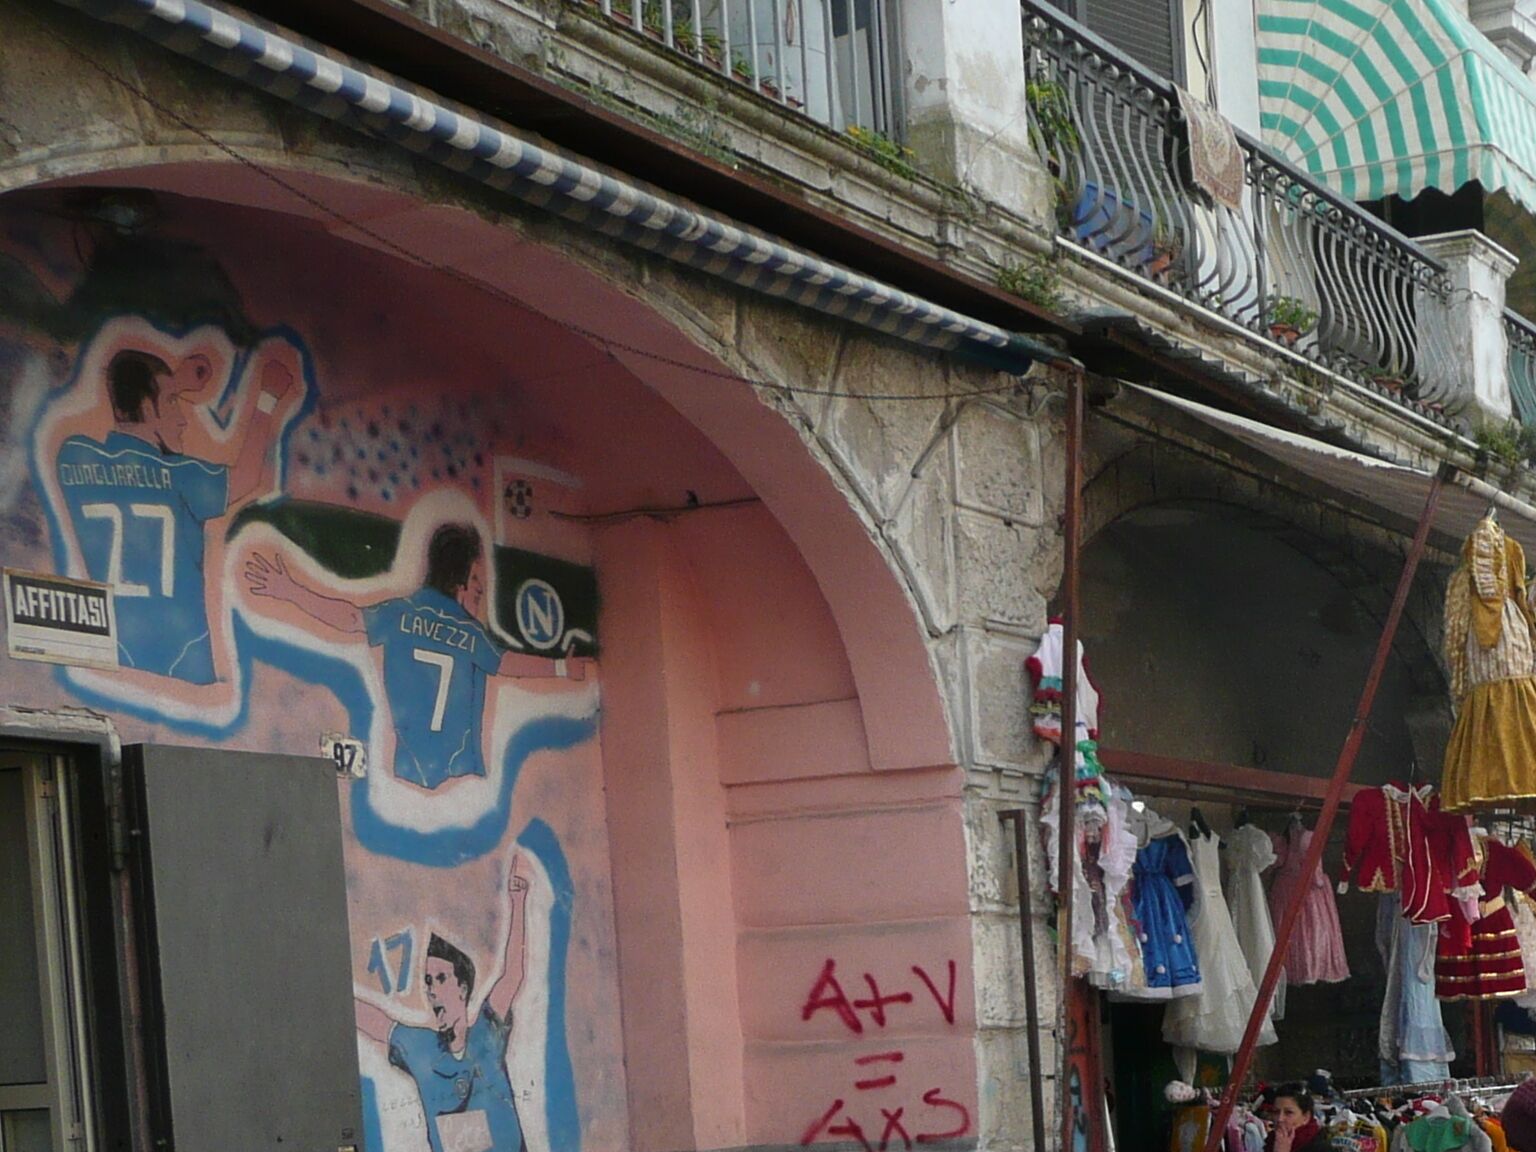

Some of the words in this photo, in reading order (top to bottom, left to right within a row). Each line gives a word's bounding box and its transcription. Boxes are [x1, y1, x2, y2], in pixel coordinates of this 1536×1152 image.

[81, 503, 175, 598] 27
[15, 584, 107, 628] AFFITTASI
[527, 591, 553, 638] N
[400, 613, 476, 654] LAVEZZI
[413, 648, 454, 732] 7
[333, 742, 357, 772] 97
[367, 929, 414, 995] 17
